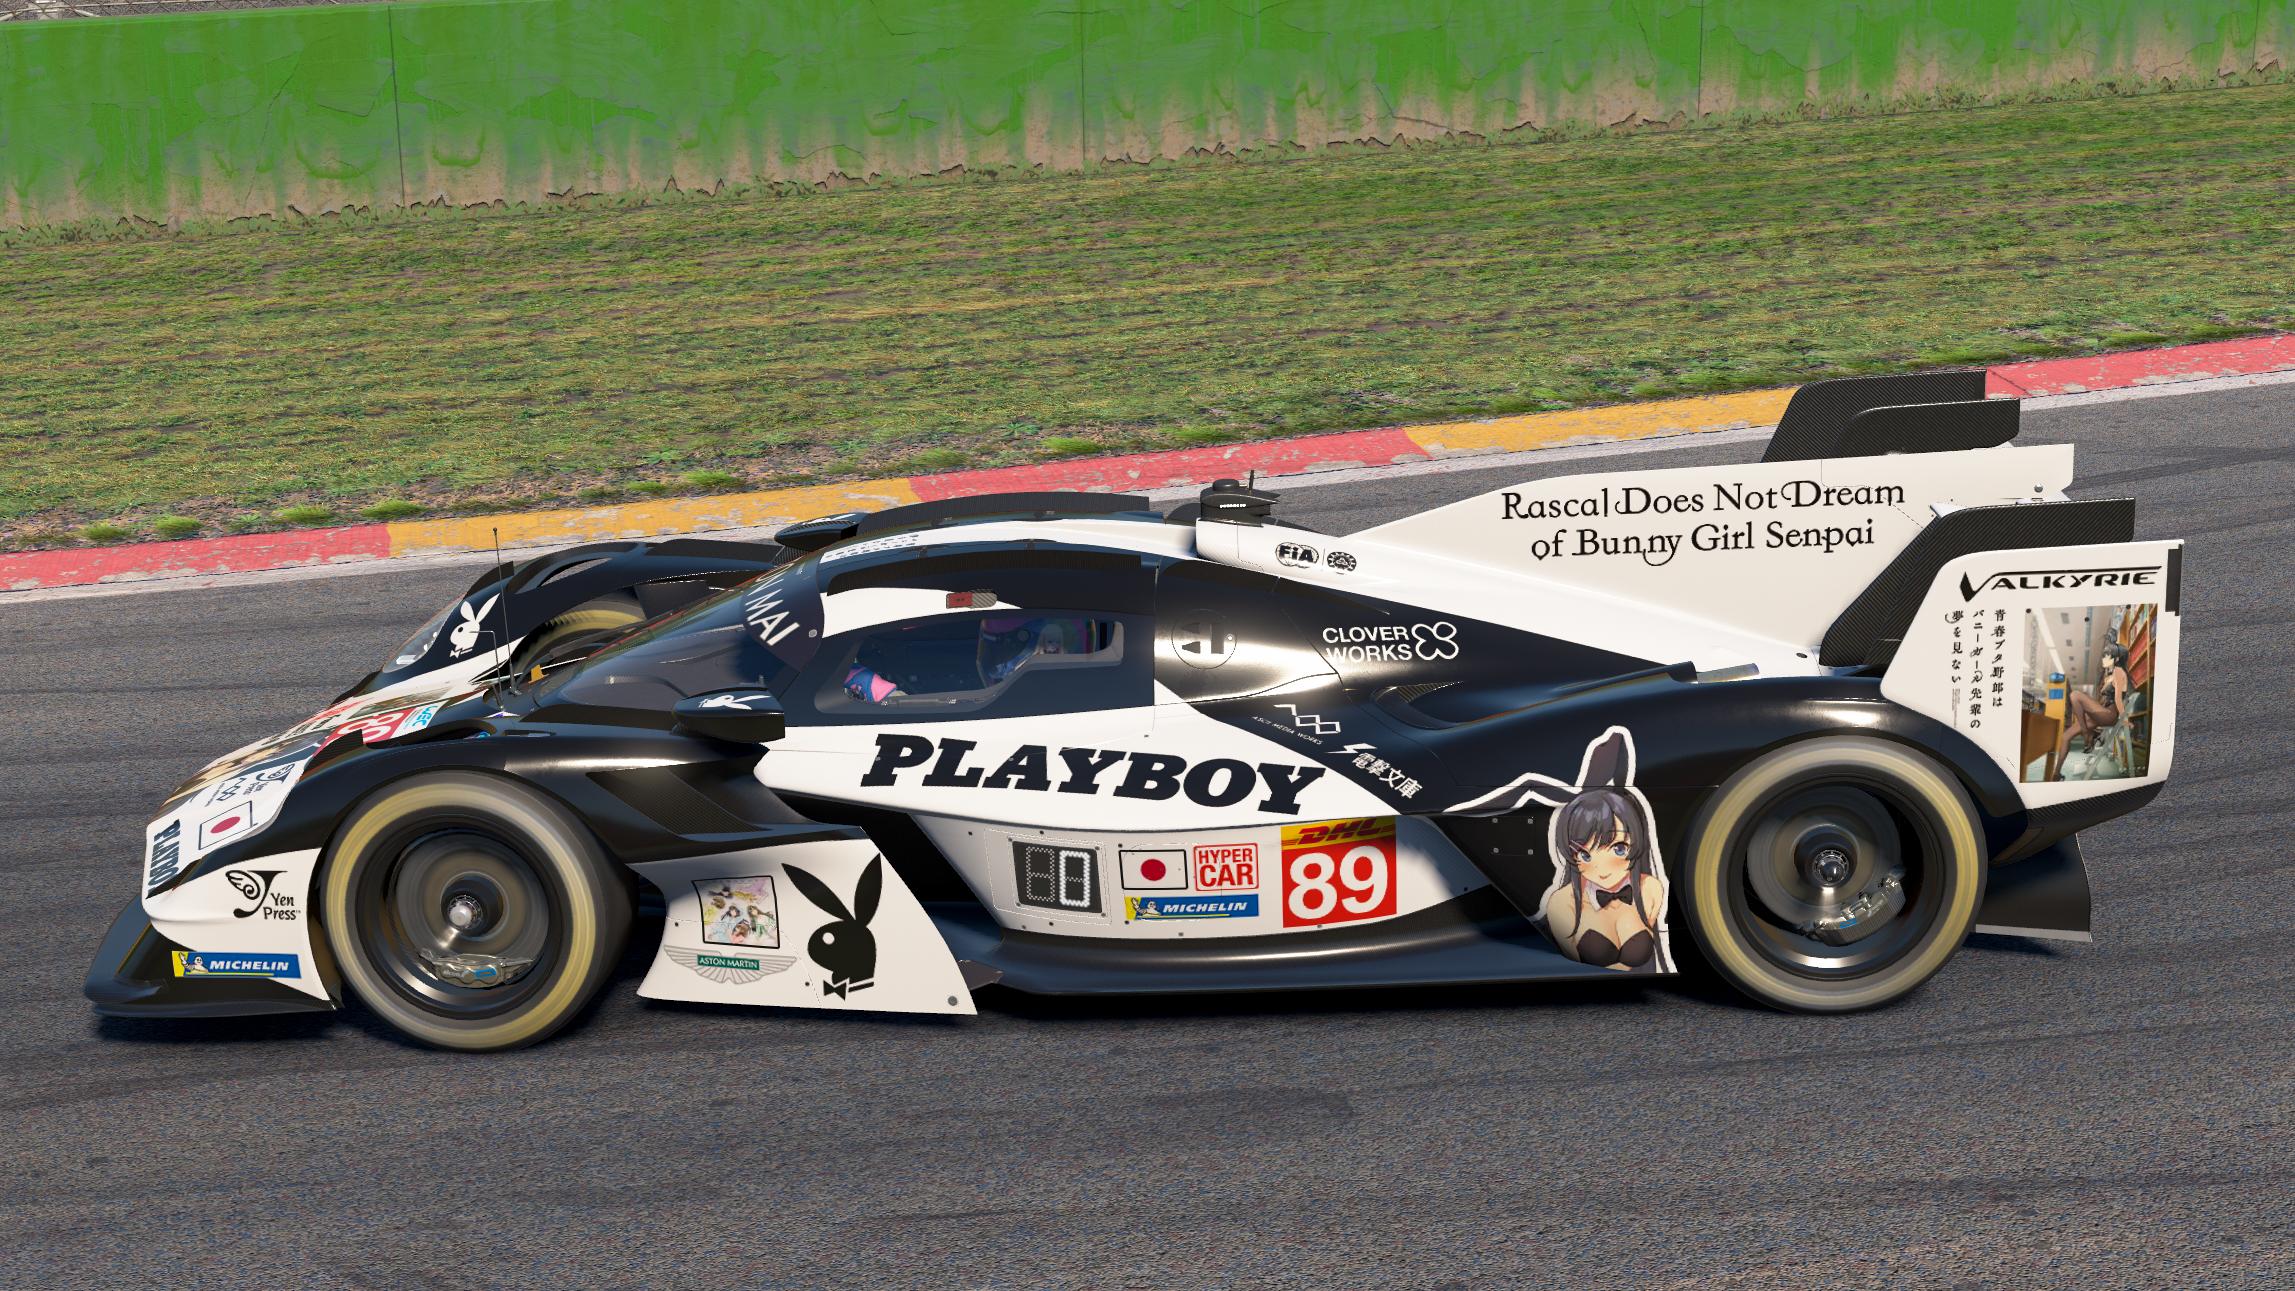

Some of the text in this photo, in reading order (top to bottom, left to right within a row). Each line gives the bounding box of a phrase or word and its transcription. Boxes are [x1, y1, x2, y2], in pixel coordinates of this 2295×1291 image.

[1502, 480, 1905, 519] Rascal Does Not Dream
[1531, 518, 1875, 566] of Bunny Girl Senpai
[1960, 566, 2162, 602] VALKYRIE
[1322, 626, 1410, 644] CLOVER
[1325, 643, 1413, 663] WORKS
[1272, 723, 1295, 734] MEDIA
[1297, 732, 1324, 745] WORKS
[860, 733, 1326, 816] PLAYBOY
[1352, 752, 1423, 799] 電撃文庫
[1298, 817, 1381, 845] DHL
[147, 819, 181, 894] PLAYBO
[1198, 848, 1253, 865] HYPER
[1199, 863, 1254, 888] CAR
[1288, 845, 1389, 920] 89
[270, 892, 295, 906] Yen
[1162, 902, 1248, 913] MICHELIN
[210, 960, 289, 971] MICHELIN
[699, 957, 758, 969] ASTON MARTIN
